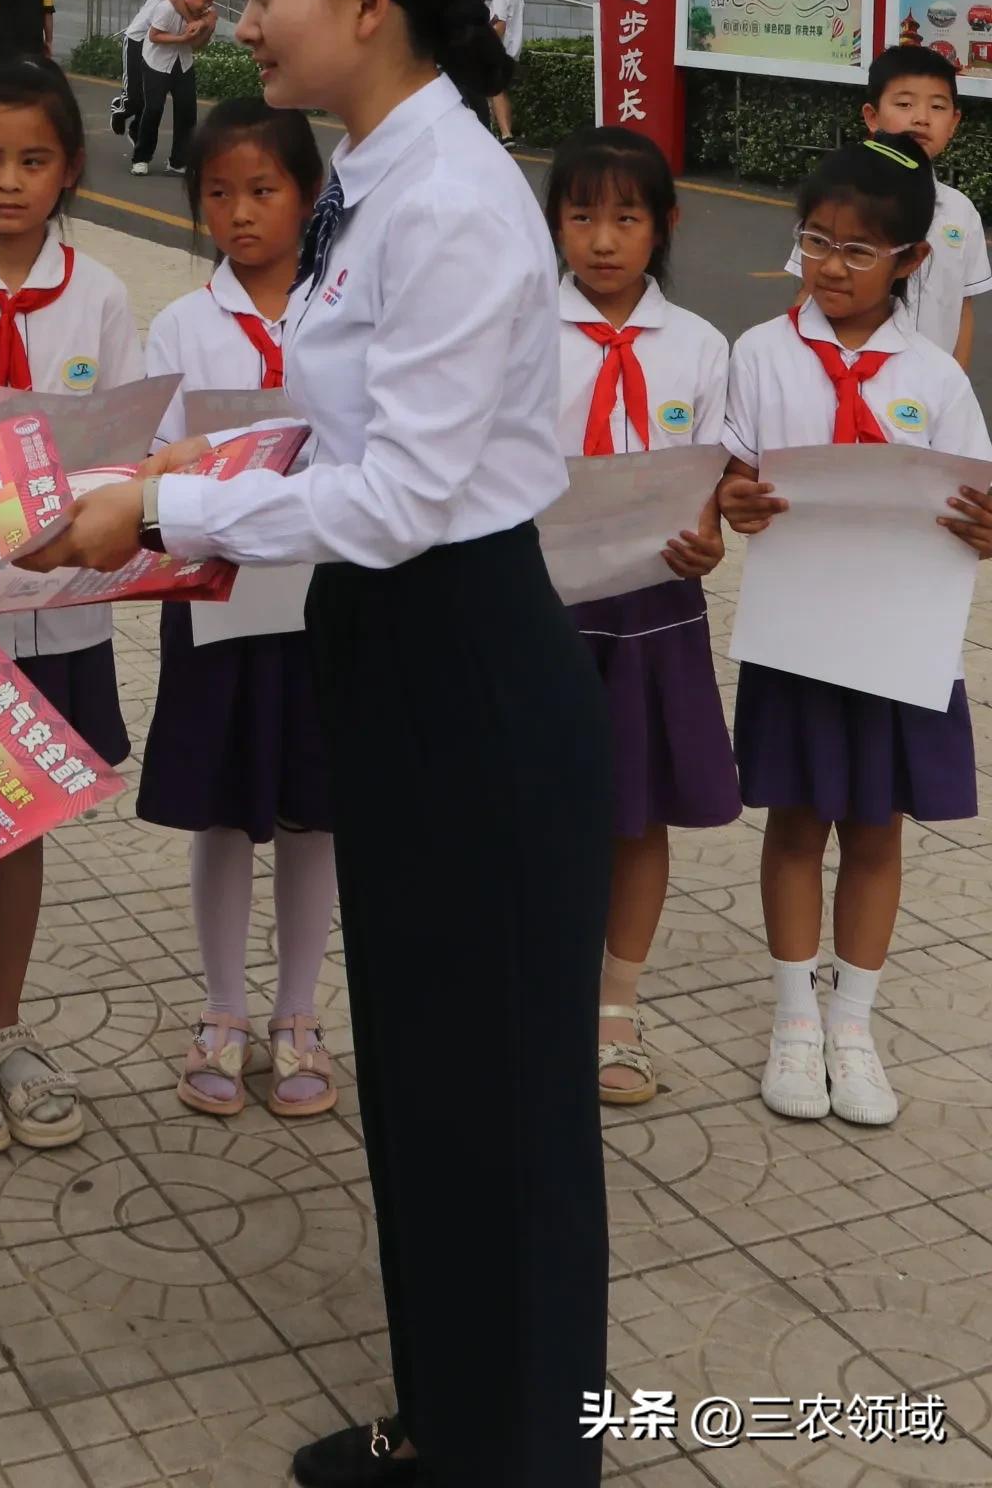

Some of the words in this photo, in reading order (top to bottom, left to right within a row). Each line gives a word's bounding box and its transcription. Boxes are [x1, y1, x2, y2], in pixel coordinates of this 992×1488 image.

[764, 23, 791, 36] 绿色校园
[795, 23, 823, 37] 你我共享
